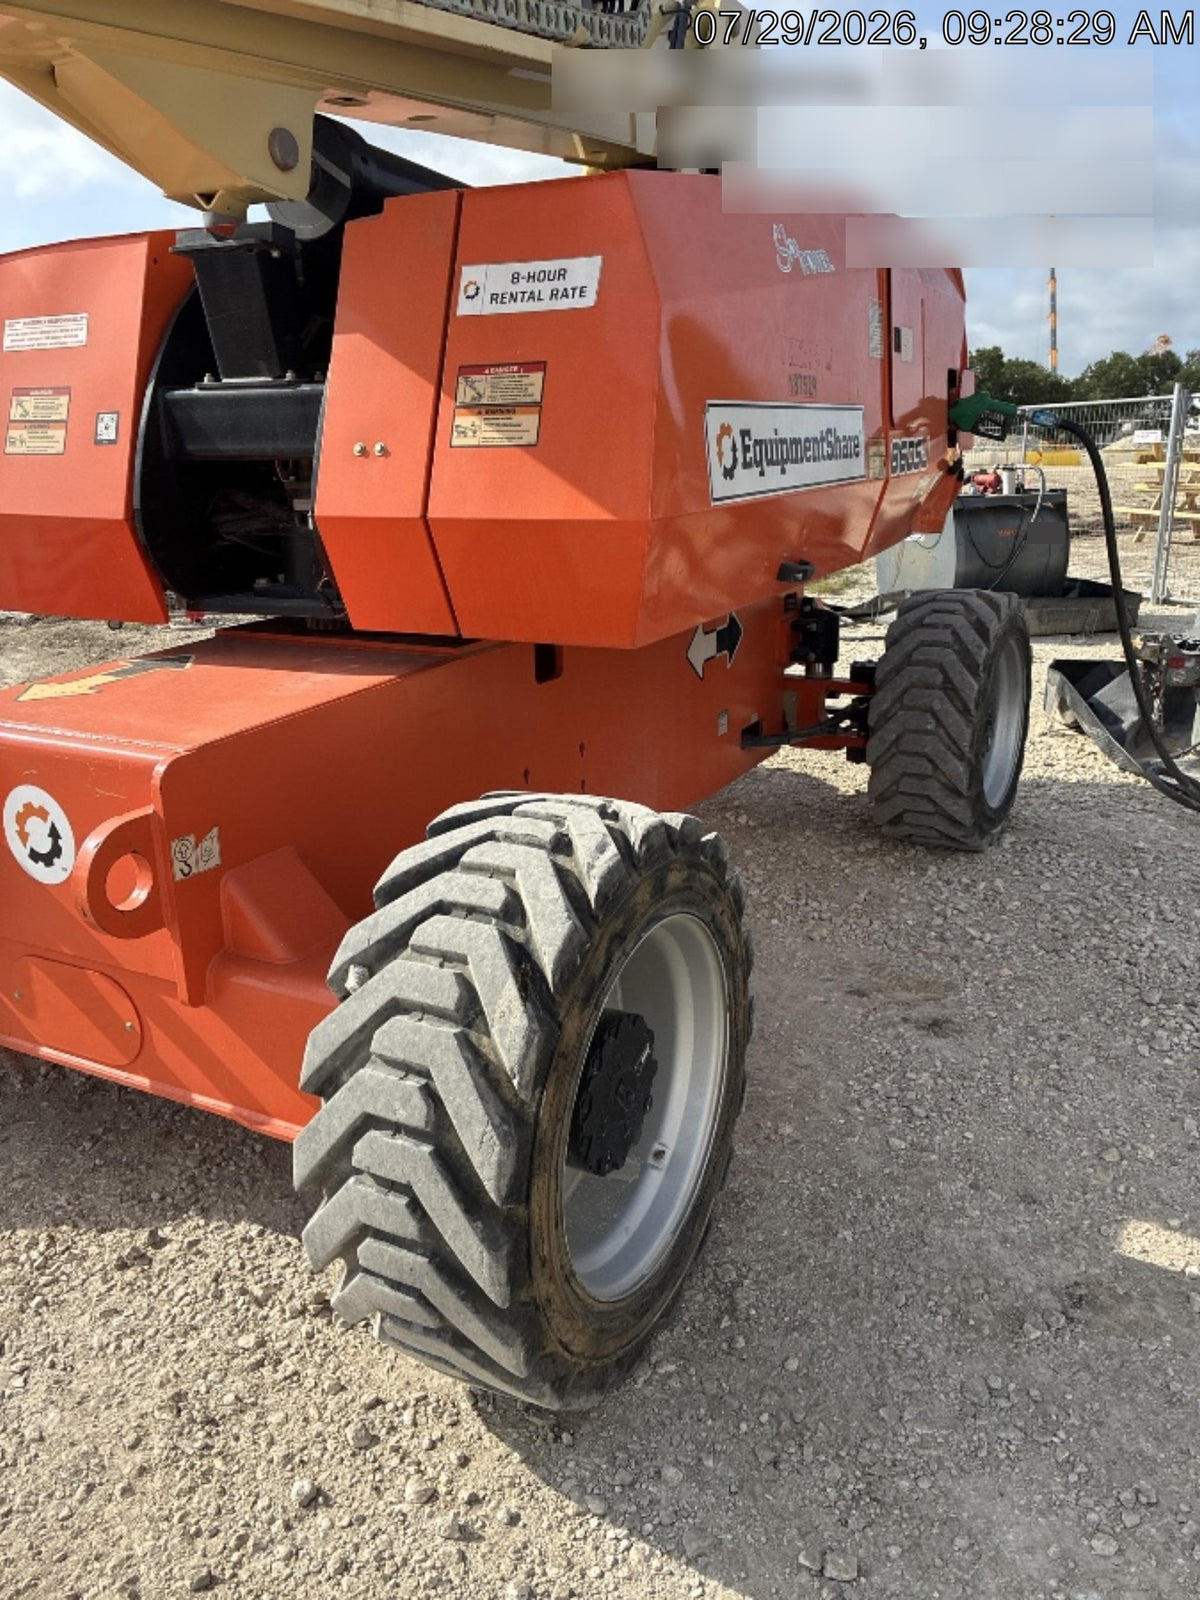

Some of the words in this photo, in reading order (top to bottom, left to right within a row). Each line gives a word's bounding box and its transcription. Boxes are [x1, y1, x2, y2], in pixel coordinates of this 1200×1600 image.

[511, 268, 567, 284] 8-HOUR
[490, 290, 544, 305] RENTAL
[549, 285, 588, 300] RATE
[739, 427, 861, 477] EquipmentShare
